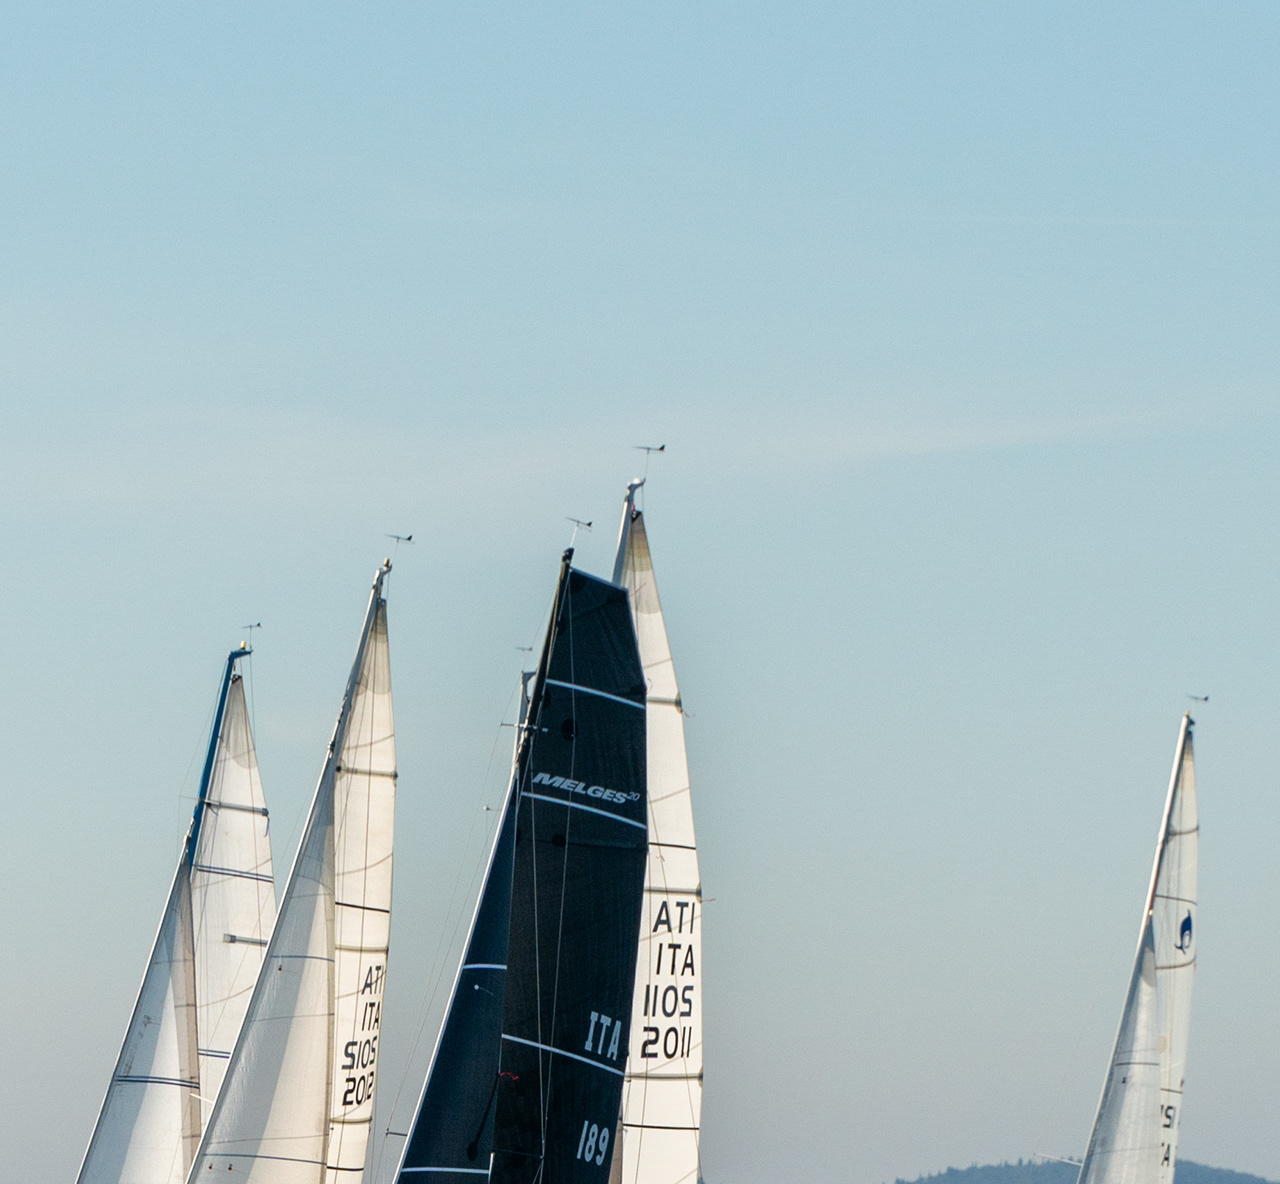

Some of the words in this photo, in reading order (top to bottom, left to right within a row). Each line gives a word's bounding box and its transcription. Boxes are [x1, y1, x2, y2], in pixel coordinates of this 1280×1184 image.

[655, 942, 695, 977] ITA
[361, 1001, 381, 1032] ITA
[584, 1010, 622, 1061] ITA
[640, 1026, 693, 1059] 2011
[341, 1070, 376, 1106] 2012
[576, 1120, 610, 1166] 189
